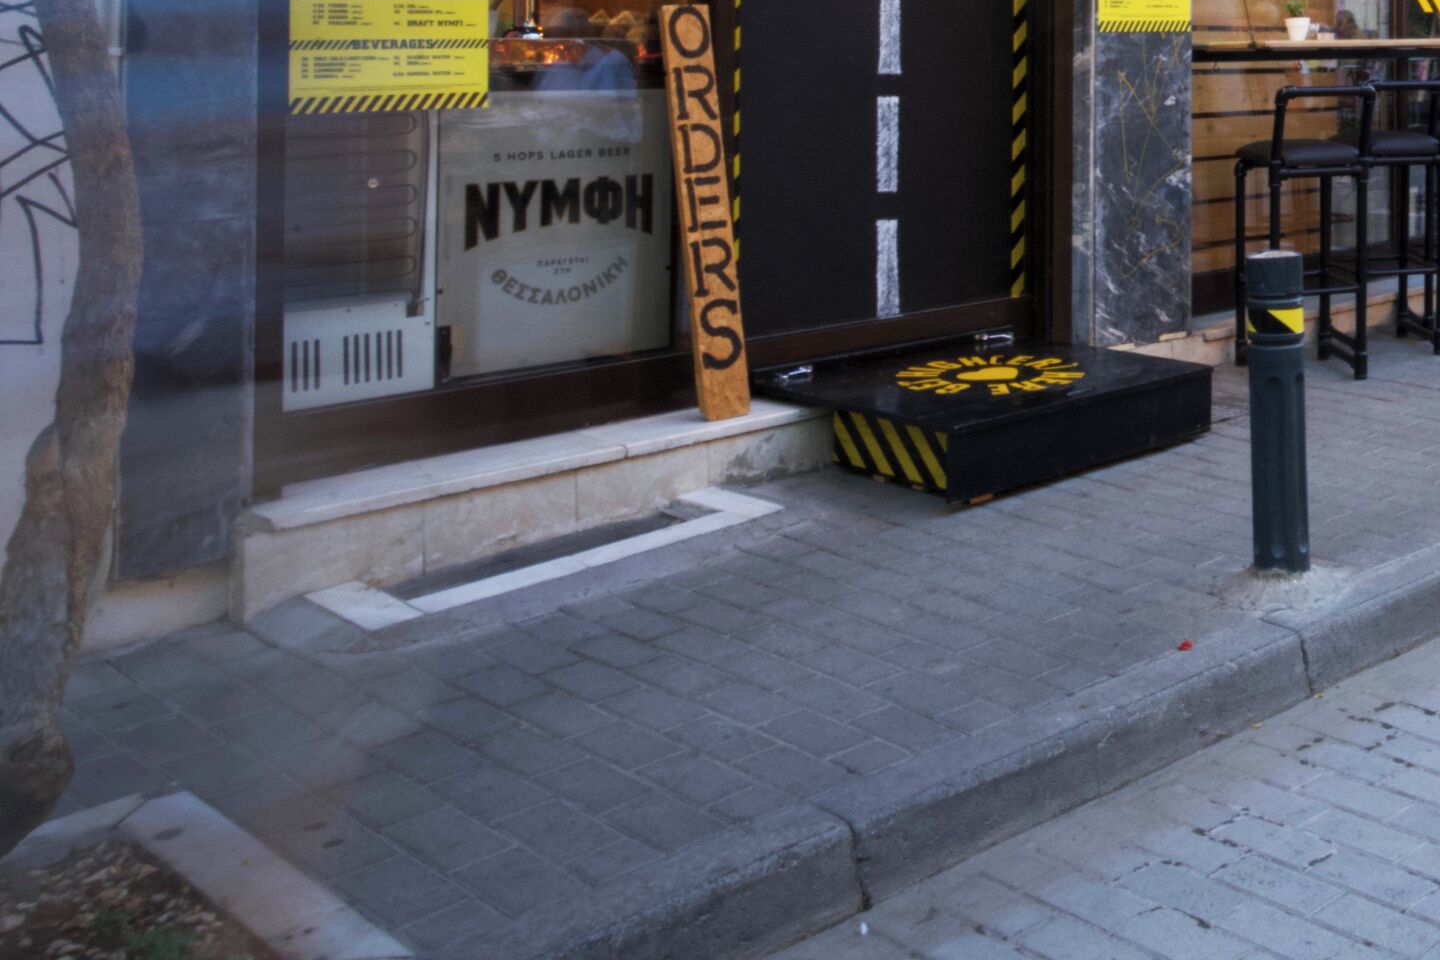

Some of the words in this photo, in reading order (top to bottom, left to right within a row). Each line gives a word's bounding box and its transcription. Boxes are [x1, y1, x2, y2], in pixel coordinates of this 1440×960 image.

[352, 39, 434, 50] BEVERAGES
[493, 153, 501, 162] 5
[506, 151, 544, 162] HOPS
[550, 148, 592, 160] LAGER
[598, 146, 631, 158] BEER
[463, 173, 654, 253] ΝΥΜΦΗ
[668, 5, 743, 371] ORDERS
[491, 255, 629, 306] ΘΕΣΣΑΛΟΝΙΚΗ
